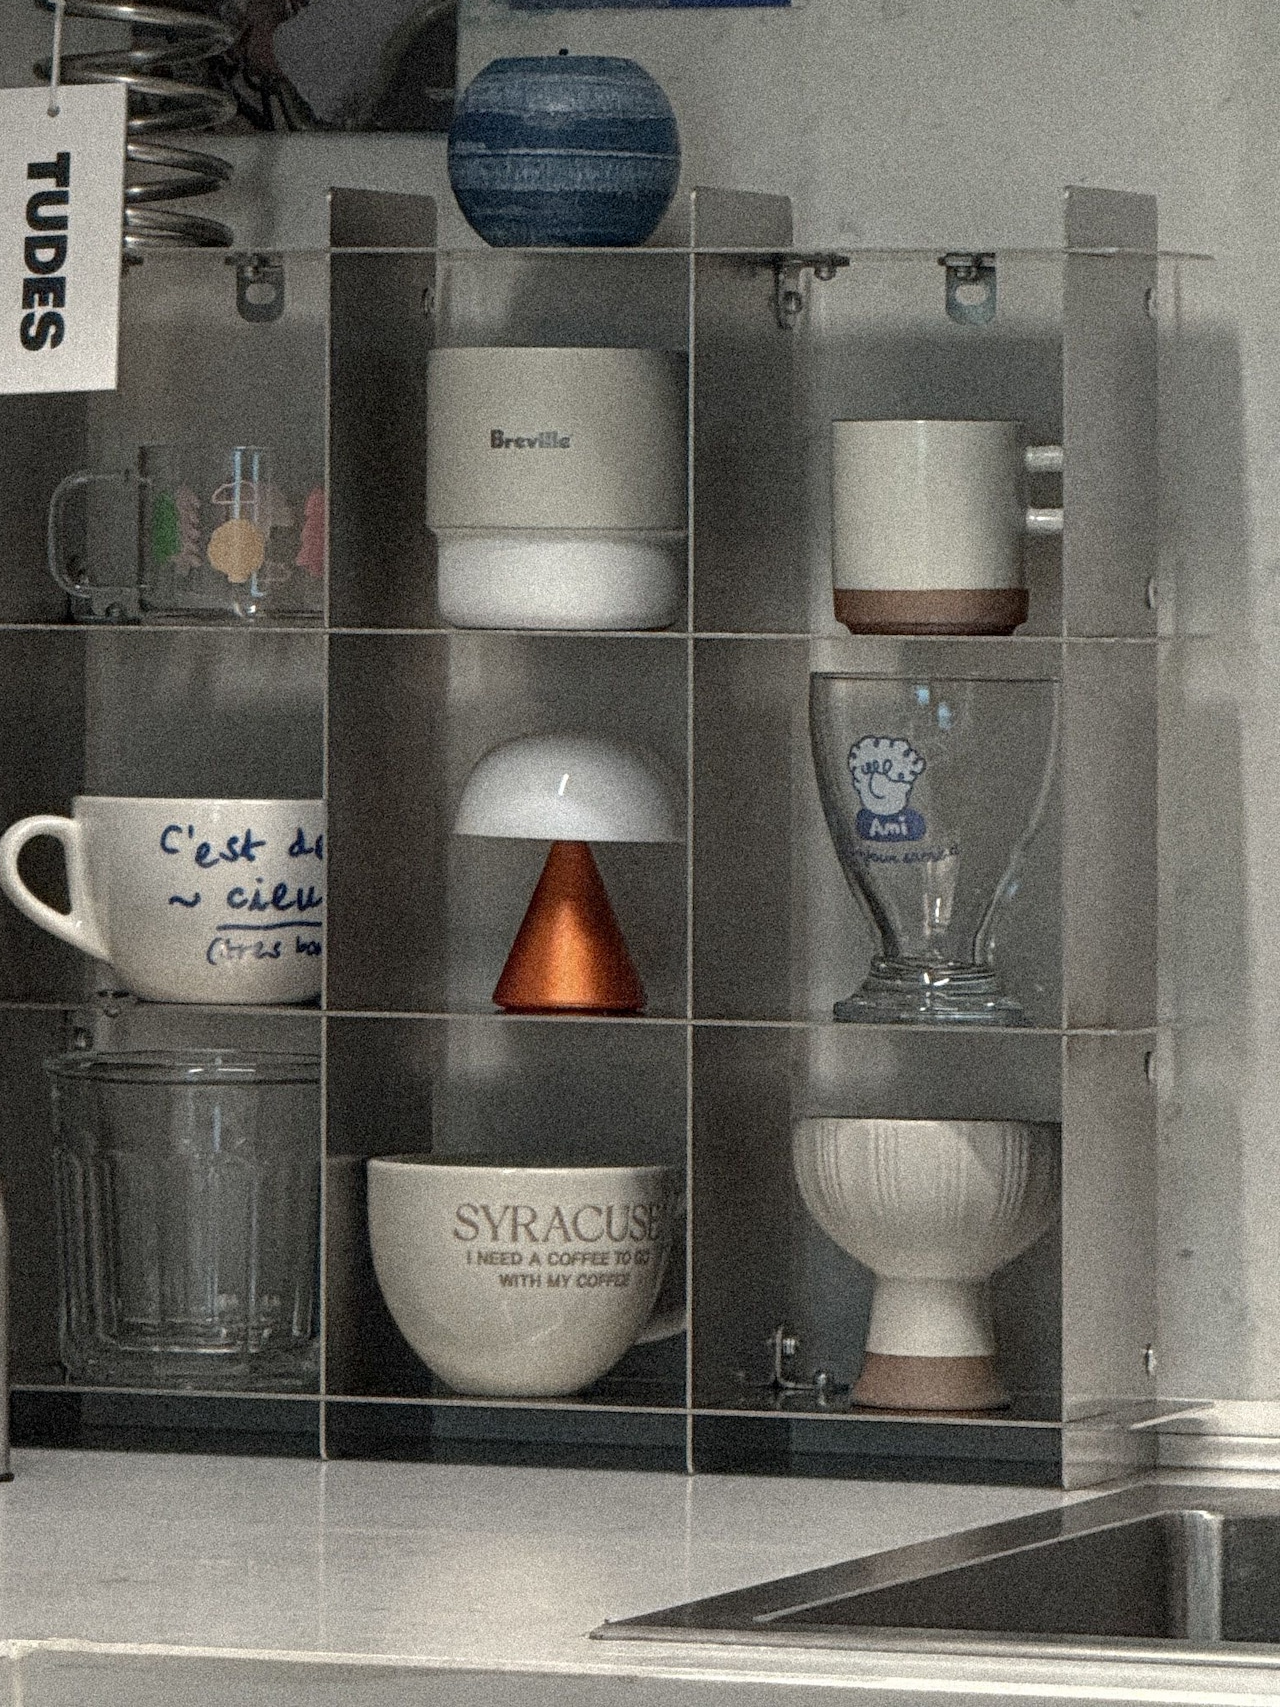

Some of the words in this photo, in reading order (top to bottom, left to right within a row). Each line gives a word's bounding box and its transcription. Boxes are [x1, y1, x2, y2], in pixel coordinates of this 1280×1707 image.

[20, 152, 71, 351] TUDES
[490, 428, 572, 449] Breville
[869, 816, 909, 837] Ami
[160, 824, 266, 868] C'est
[453, 1202, 662, 1243] SYRACUSE
[477, 1251, 522, 1266] NEED
[528, 1252, 542, 1267] A
[547, 1251, 609, 1267] COFFEE
[614, 1251, 632, 1265] TO
[499, 1273, 541, 1287] WITH
[547, 1274, 571, 1288] MY
